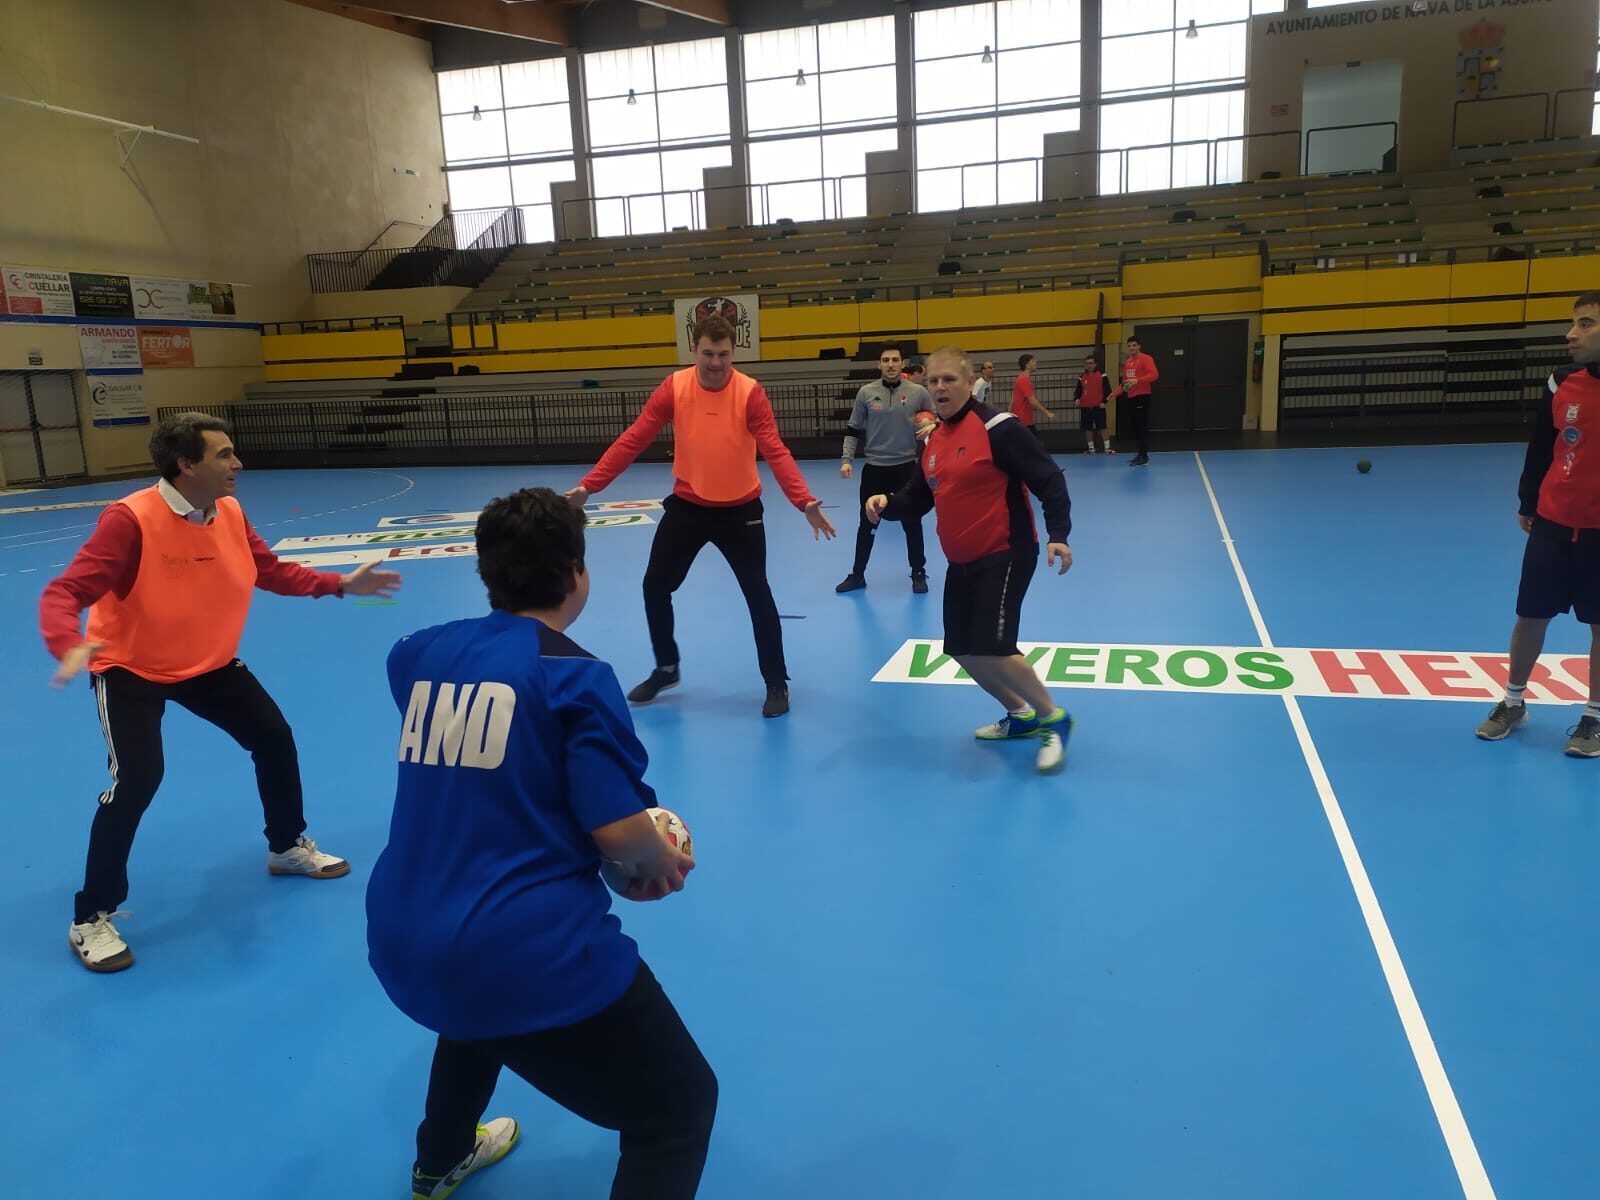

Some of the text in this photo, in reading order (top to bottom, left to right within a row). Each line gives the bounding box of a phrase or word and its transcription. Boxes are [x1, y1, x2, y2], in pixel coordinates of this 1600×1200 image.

[1266, 8, 1377, 35] AYUNTAMIENTO
[1382, 6, 1401, 21] DE
[1454, 0, 1473, 12] DE
[80, 327, 135, 338] ARMANDO
